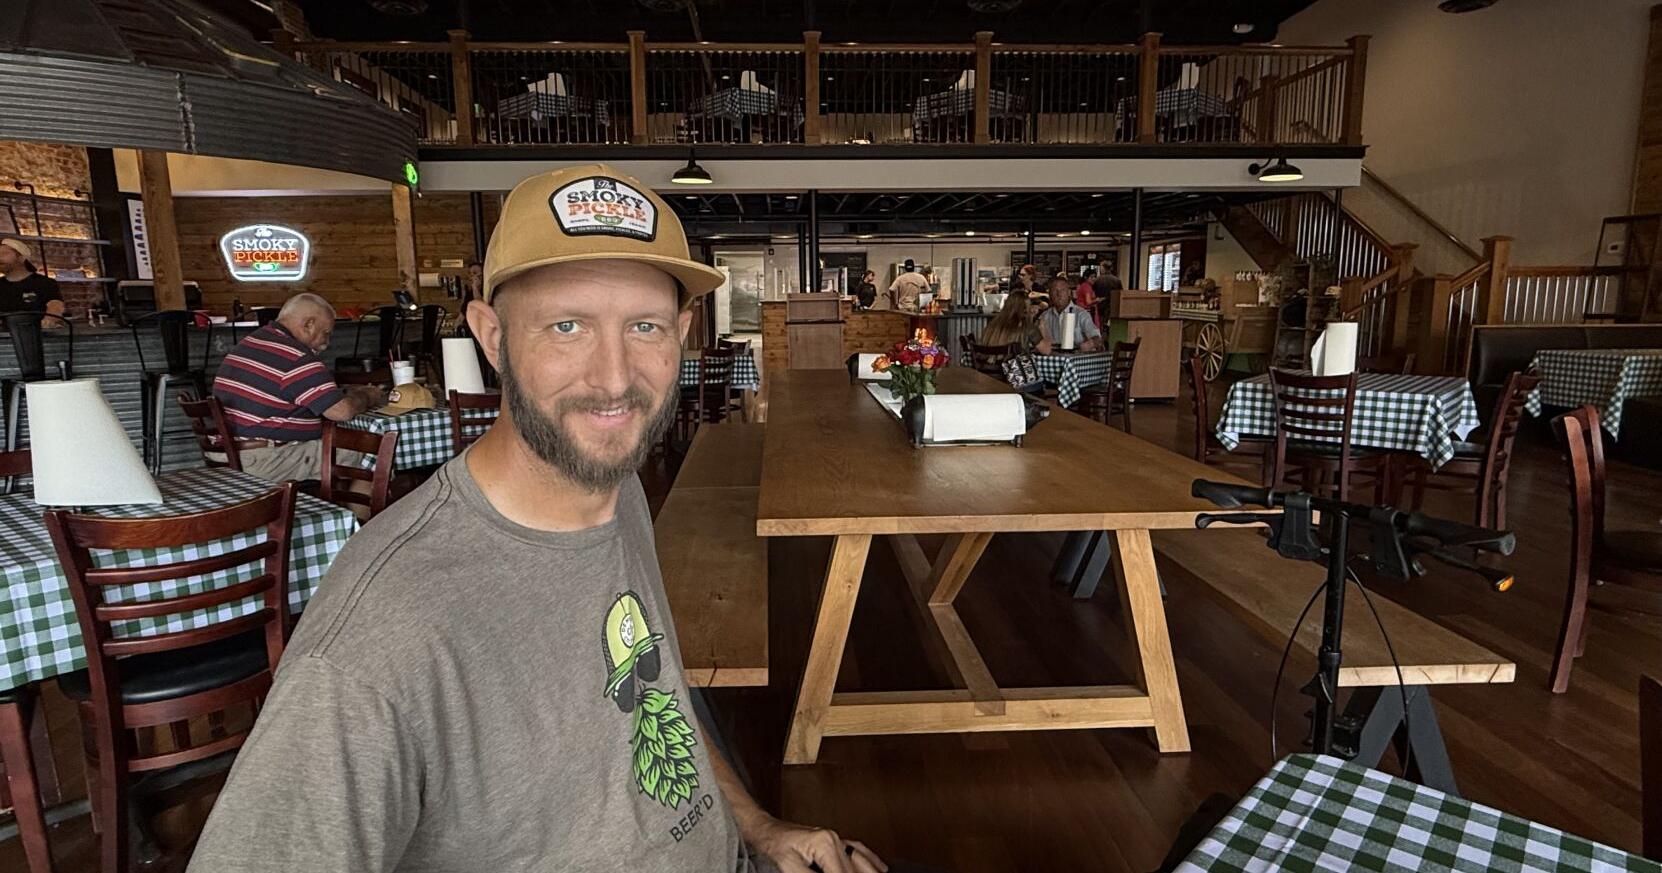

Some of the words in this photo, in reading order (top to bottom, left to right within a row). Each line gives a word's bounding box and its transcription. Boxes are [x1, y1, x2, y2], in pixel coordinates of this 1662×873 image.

[567, 190, 643, 209] SMOKY
[568, 203, 647, 222] PICKLE
[232, 239, 299, 251] SMOKY
[233, 251, 299, 262] PICKLE
[669, 794, 714, 843] BEER'D
